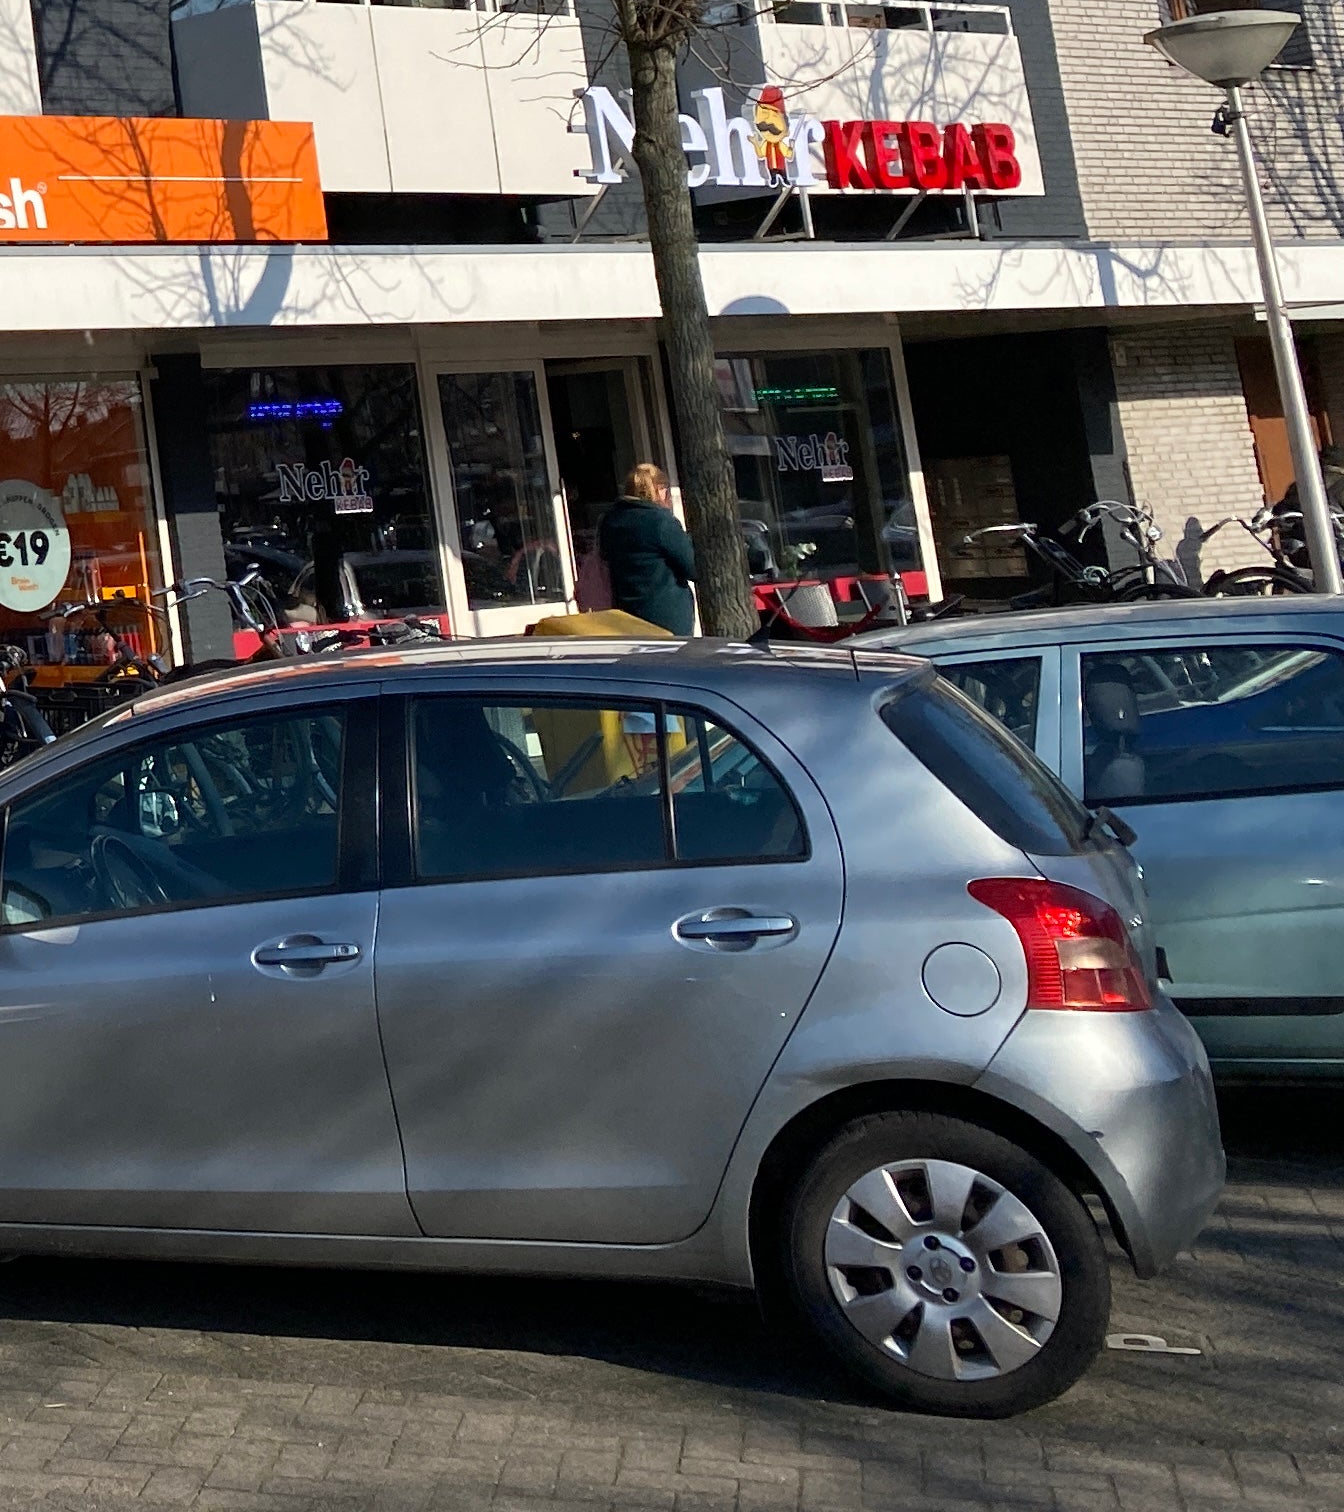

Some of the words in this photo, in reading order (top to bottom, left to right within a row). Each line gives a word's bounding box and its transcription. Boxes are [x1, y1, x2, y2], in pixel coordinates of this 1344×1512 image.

[584, 86, 825, 188] Nehr
[820, 119, 1022, 191] KEBAB
[775, 433, 850, 472] Nehr
[275, 457, 370, 502] Nehr
